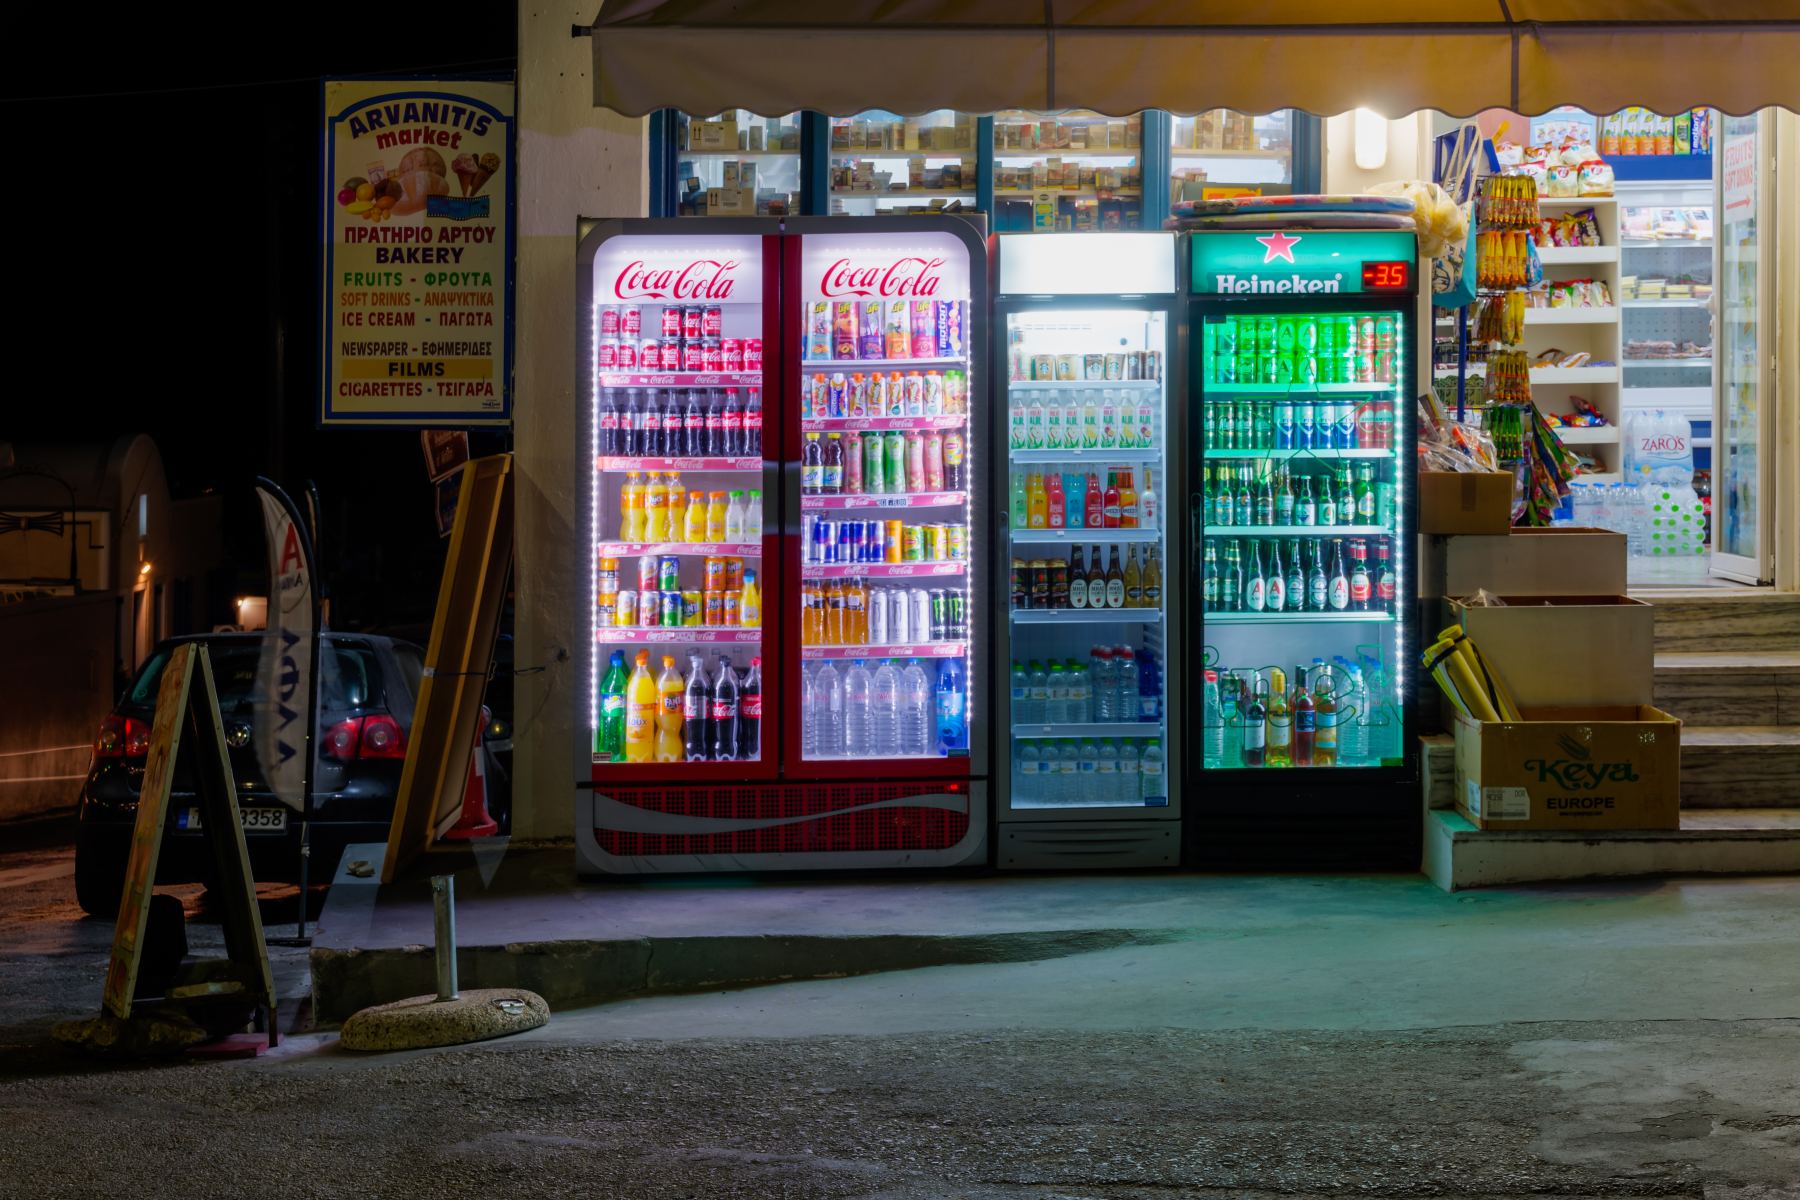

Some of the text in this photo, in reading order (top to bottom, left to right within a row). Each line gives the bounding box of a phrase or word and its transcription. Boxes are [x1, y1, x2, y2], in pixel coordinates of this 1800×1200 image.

[350, 102, 492, 140] ARVANITIS
[376, 126, 462, 150] market
[345, 226, 496, 244] ΠΡΑΤΗΡΙΟ ΑΡΤΟΥ
[376, 247, 464, 264] BAKERY
[344, 272, 402, 286] FRUITS
[424, 272, 492, 286] ΦΡΟΥΤΑ
[614, 258, 741, 300] Coca-Cola
[821, 258, 948, 298] Coca-Cola
[1216, 274, 1340, 293] Heineken
[341, 292, 368, 306] SOFT
[372, 292, 411, 306] DRINKS
[424, 292, 494, 306] ΑΝΑΨΥΚΤΙΚΑ
[342, 312, 363, 326] ICE
[368, 312, 415, 326] CREAM
[440, 312, 492, 326] ΠΑΓΩΤΑ
[342, 342, 408, 356] NEWSPAPER
[422, 342, 492, 356] ΕΦΗΜΕΡΙΔΕΣ
[388, 362, 444, 376] FILMS
[340, 382, 422, 396] CIGARETTES
[437, 382, 494, 396] ΤΣΙΓΑΡΑ
[1546, 797, 1616, 810] EUROPE
